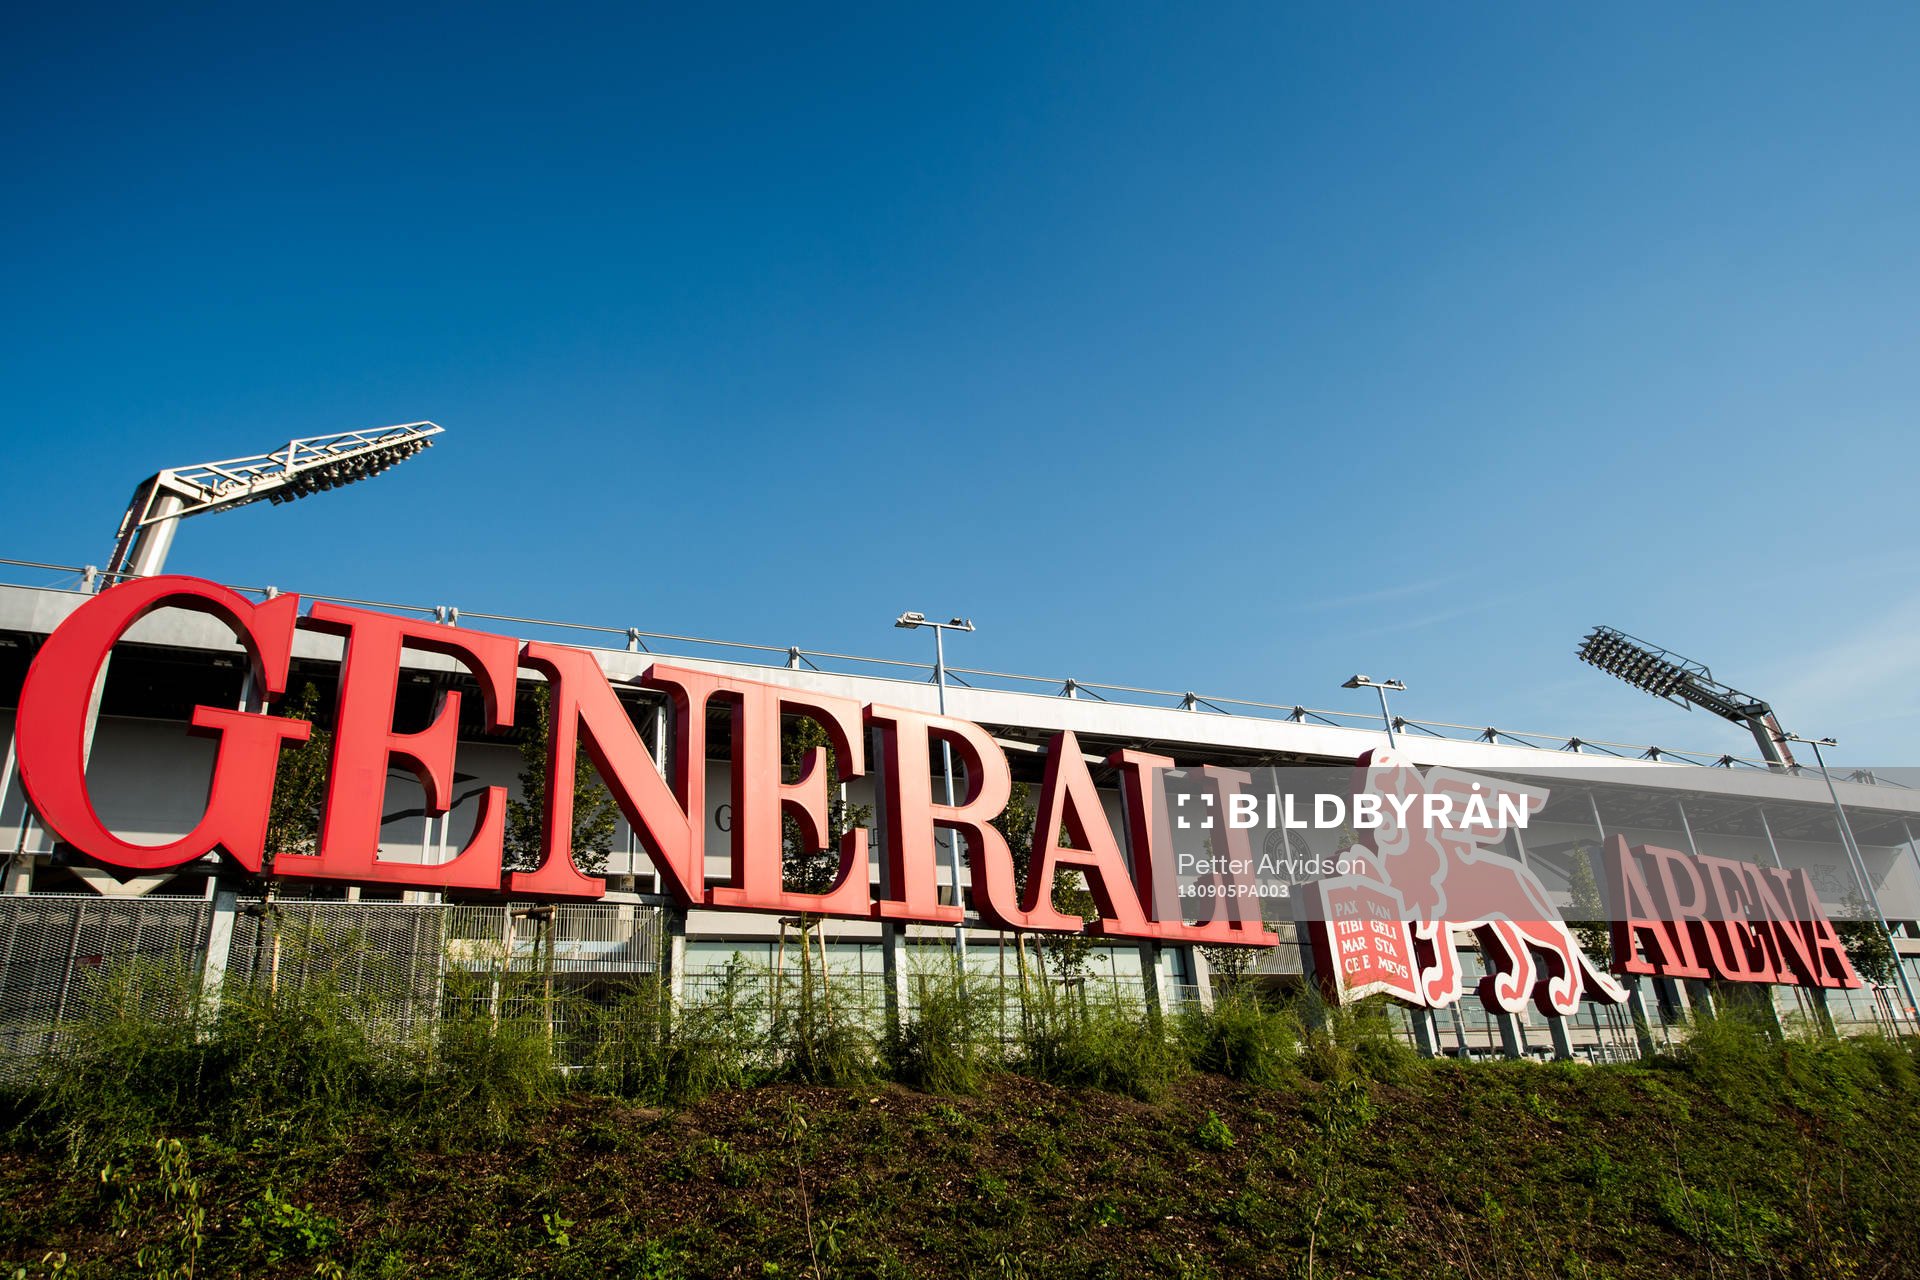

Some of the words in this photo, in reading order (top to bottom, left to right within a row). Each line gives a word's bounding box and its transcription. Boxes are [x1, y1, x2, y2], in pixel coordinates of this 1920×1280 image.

[16, 575, 1280, 946] GENERALI
[1335, 900, 1358, 916] PAX
[1367, 901, 1391, 920] VAN
[1608, 834, 1863, 989] ARENA
[1338, 918, 1364, 935] TIBI
[1370, 920, 1397, 940] GELI
[1341, 936, 1368, 954] MAR
[1374, 937, 1398, 957] STA
[1378, 956, 1409, 979] MEVS
